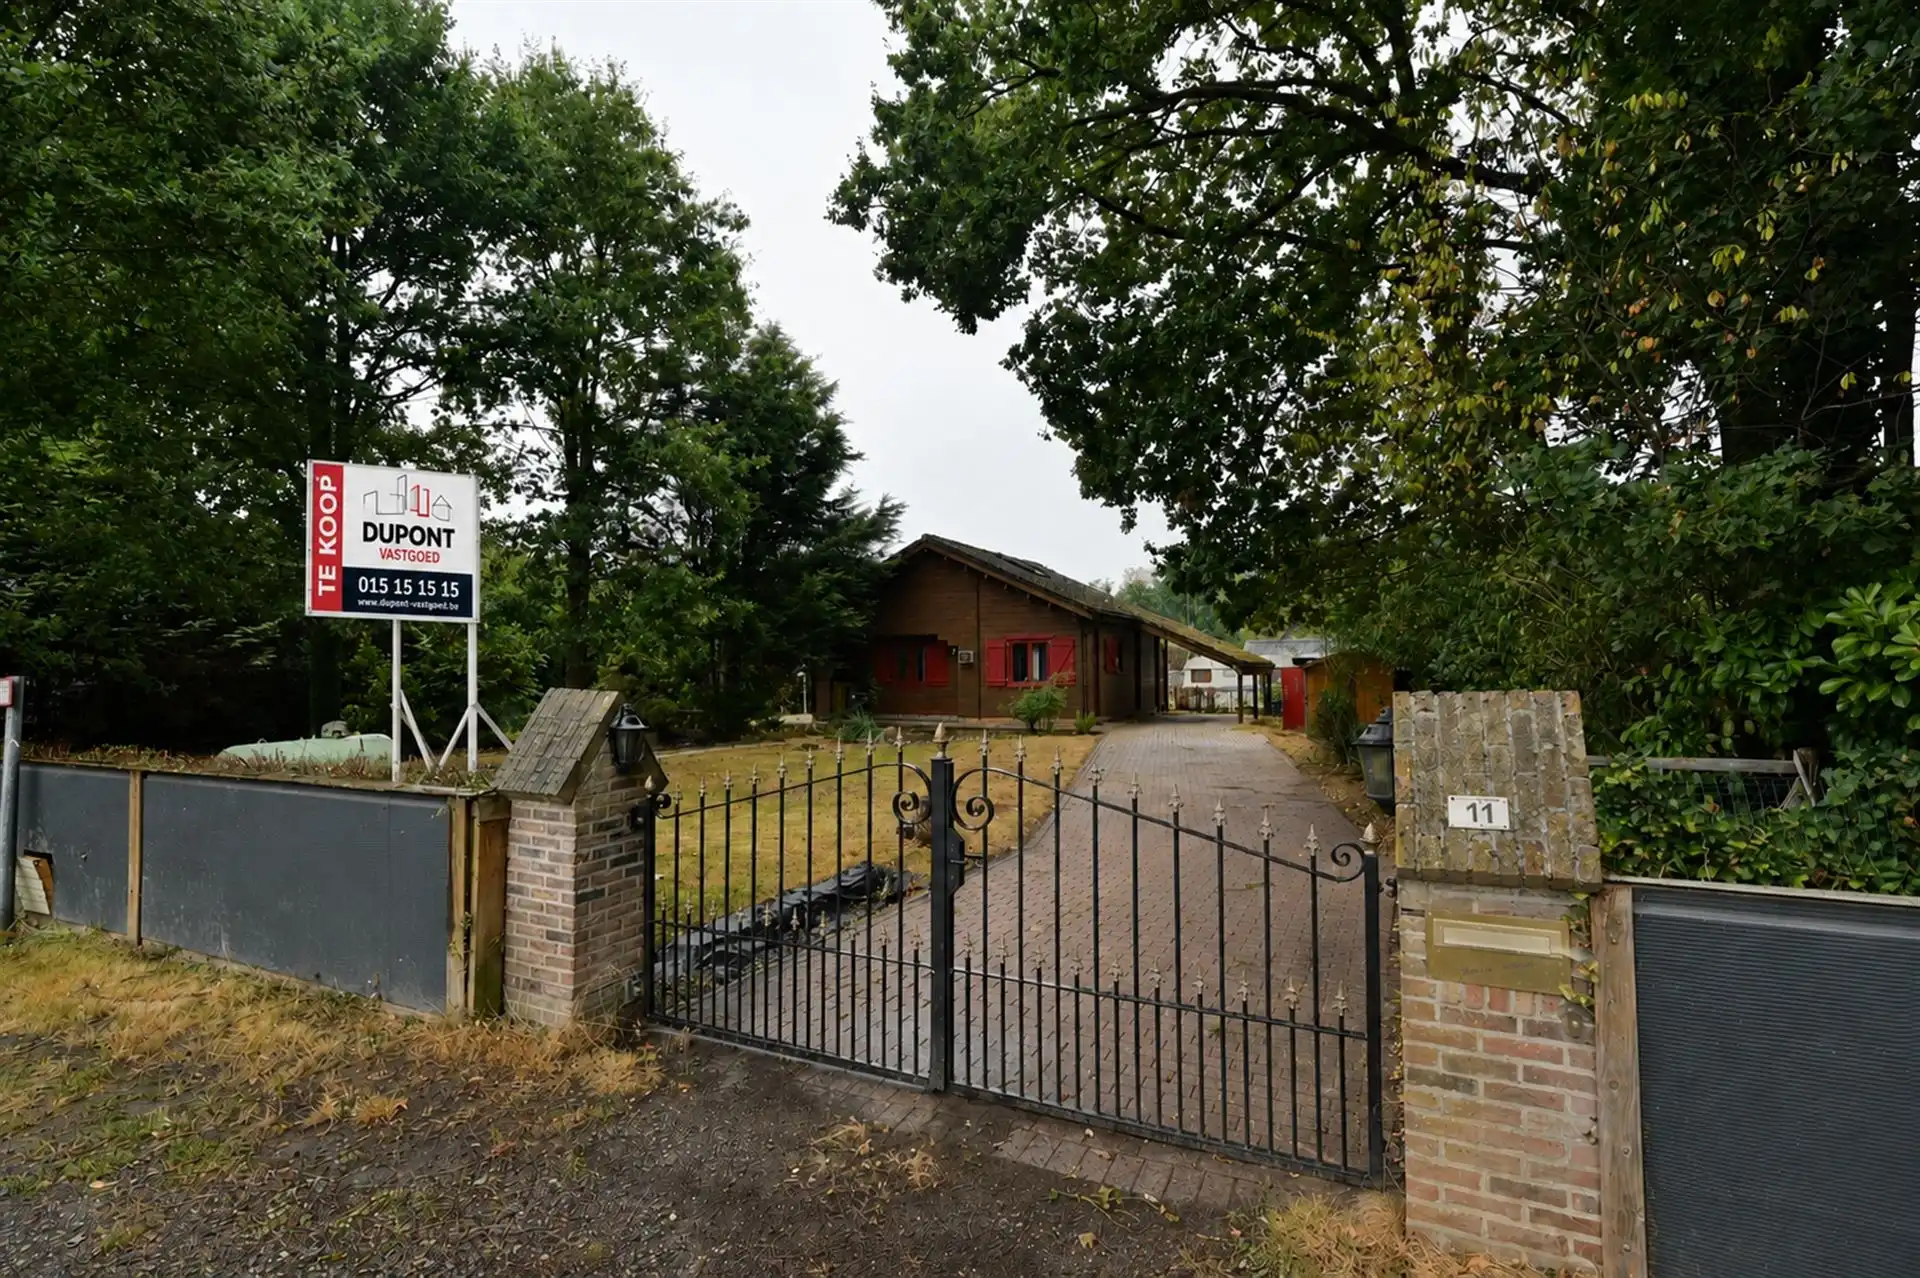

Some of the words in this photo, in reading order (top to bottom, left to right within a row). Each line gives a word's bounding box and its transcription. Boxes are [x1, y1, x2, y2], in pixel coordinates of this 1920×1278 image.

[318, 475, 337, 555] KOOP
[362, 521, 456, 548] DUPONT
[379, 548, 440, 563] VASTGOED
[318, 565, 336, 596] TE
[358, 576, 389, 594] 015
[394, 578, 413, 595] 15
[418, 580, 436, 597] 15
[441, 581, 460, 598] 15
[1465, 802, 1493, 824] 11
